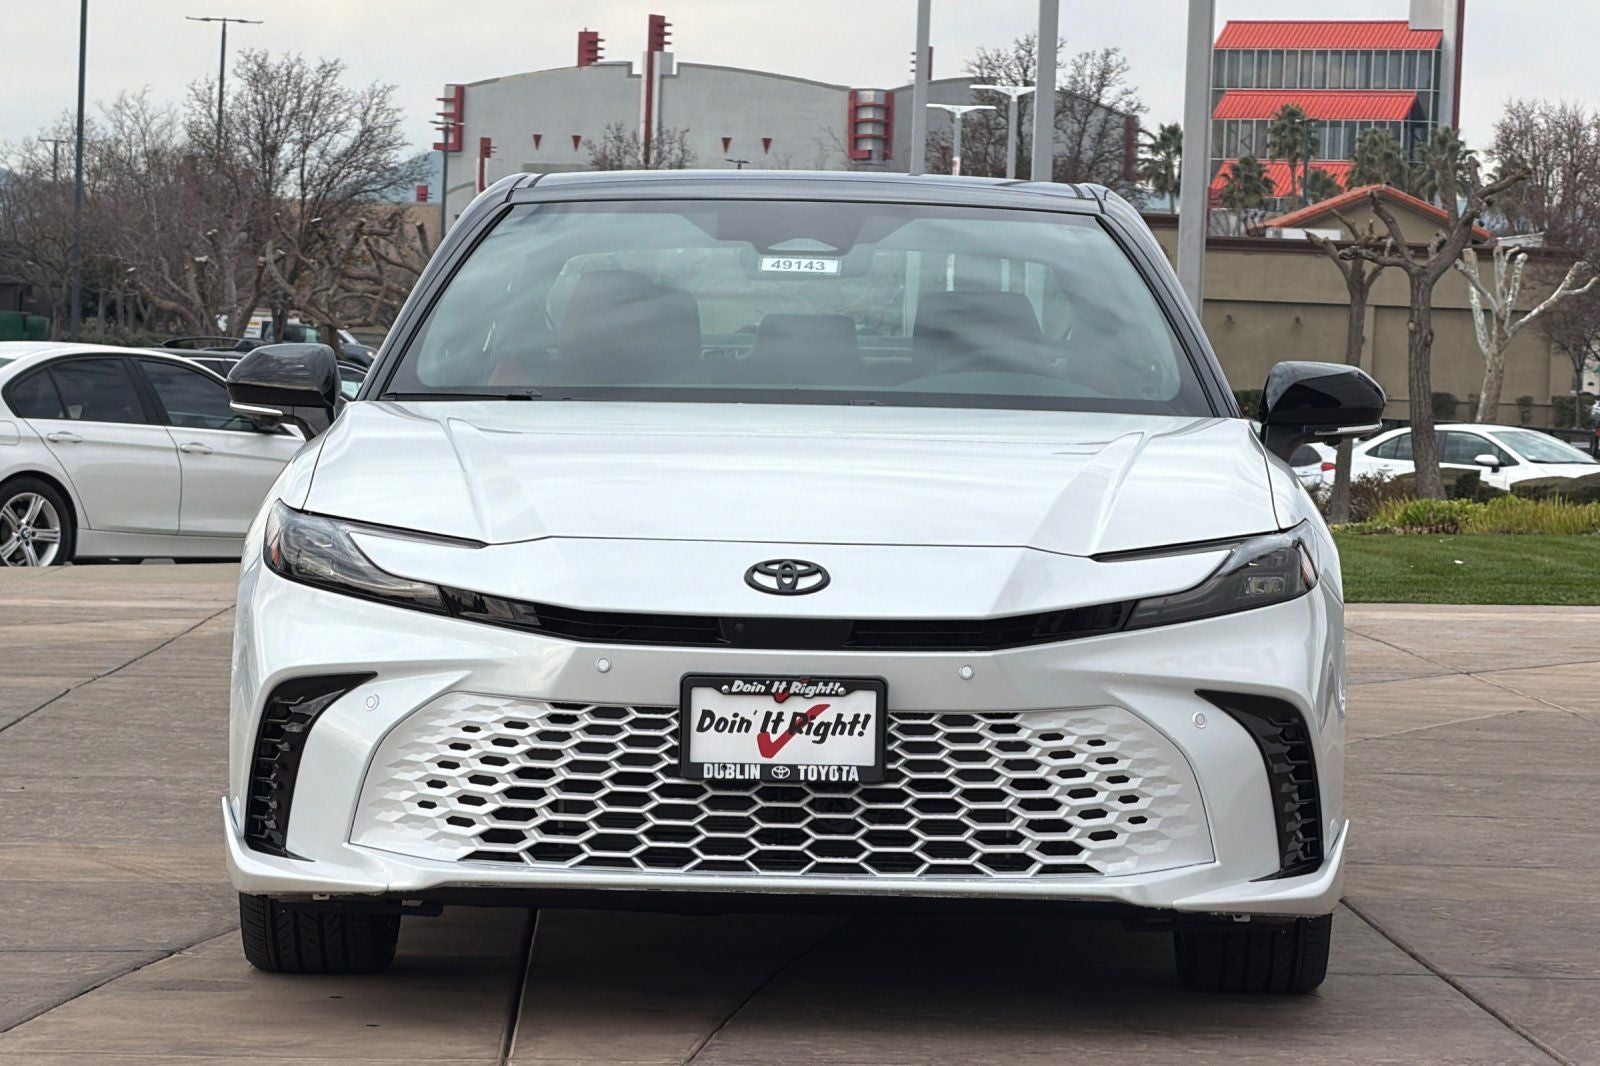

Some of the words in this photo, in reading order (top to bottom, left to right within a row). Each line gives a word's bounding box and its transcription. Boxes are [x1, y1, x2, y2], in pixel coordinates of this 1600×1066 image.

[770, 260, 825, 270] 49143
[731, 680, 770, 693] Doin'
[771, 681, 788, 693] It
[789, 682, 839, 698] Right!
[696, 709, 758, 734] Doin'
[760, 711, 785, 735] It
[789, 711, 871, 744] Right!
[704, 764, 761, 780] DUBLIN
[798, 765, 859, 781] TOYOTA
